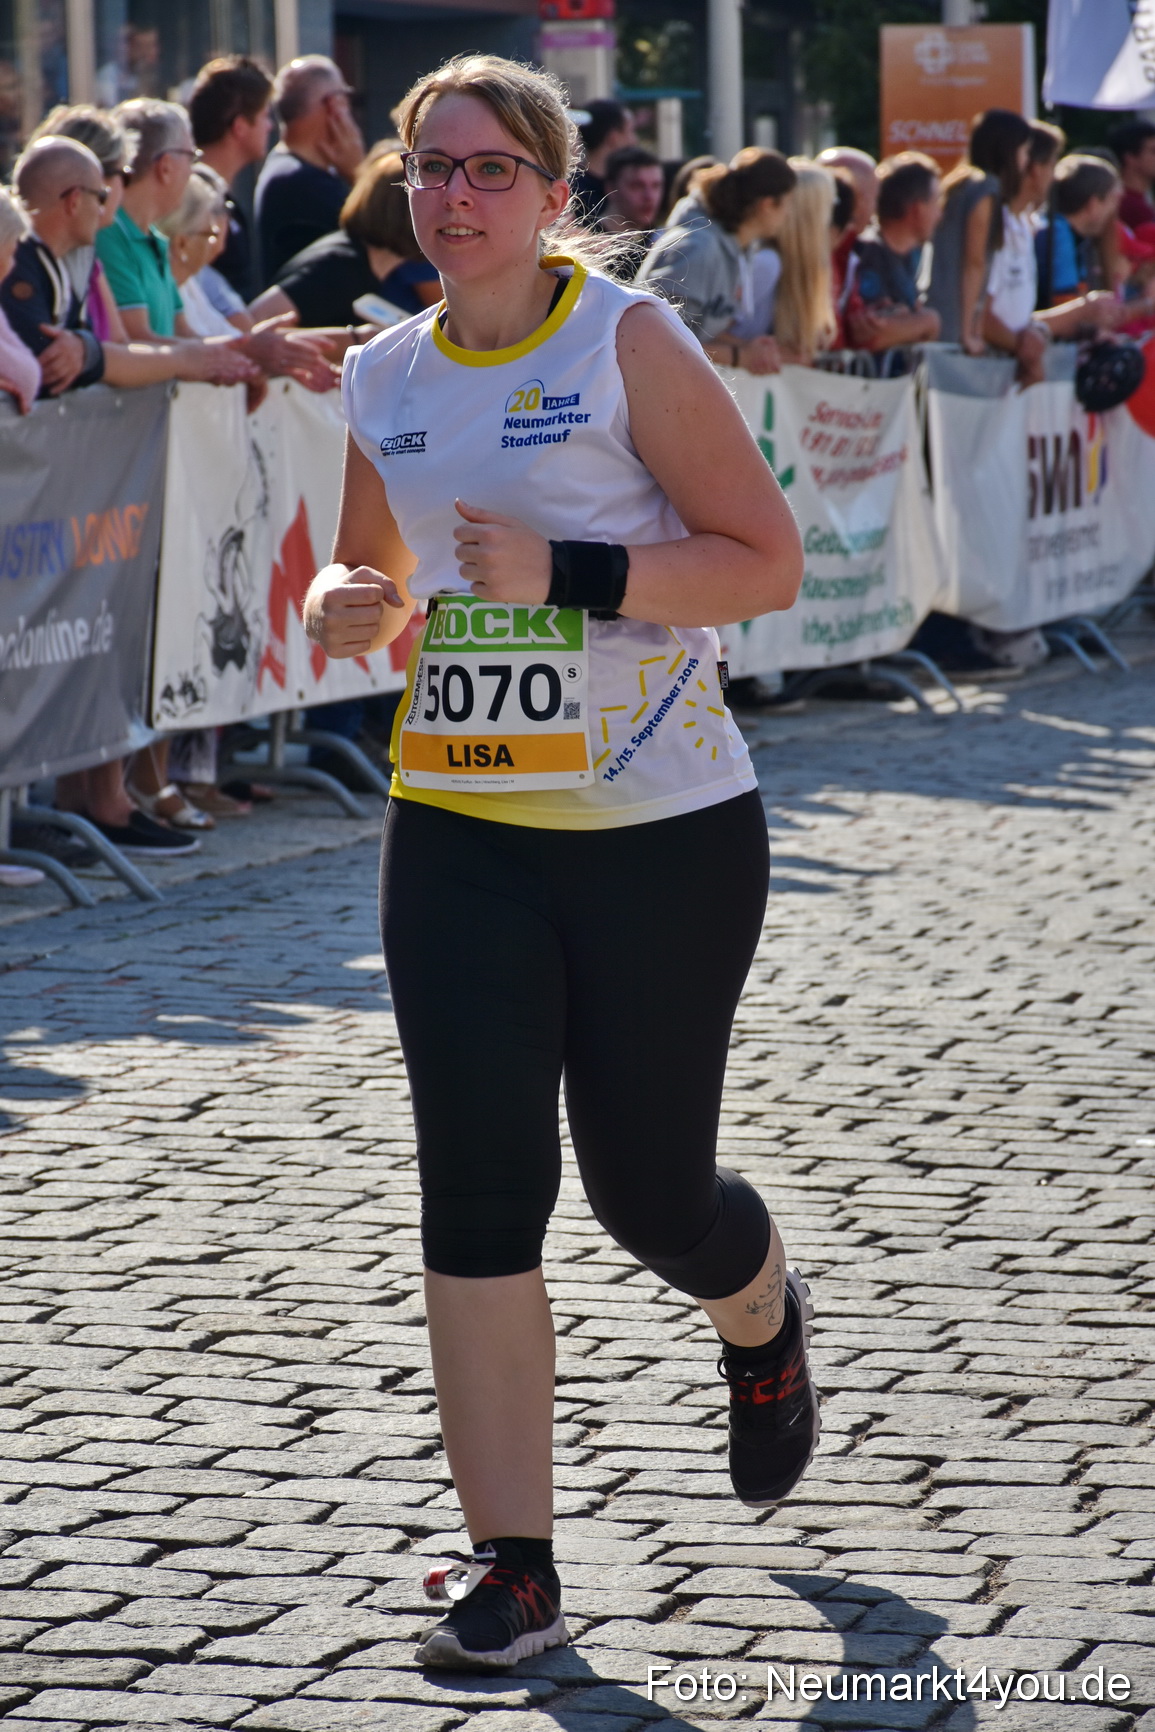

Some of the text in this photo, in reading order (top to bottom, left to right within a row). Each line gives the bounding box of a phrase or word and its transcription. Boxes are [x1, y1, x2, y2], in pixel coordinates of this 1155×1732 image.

[888, 119, 968, 144] SCHNEL
[507, 386, 578, 413] 20 JAHRE
[503, 411, 592, 430] Neumarkter
[381, 431, 427, 451] BOCK
[501, 428, 572, 449] Stadtlauf
[430, 604, 566, 644] BOCK
[424, 663, 562, 722] 5070
[603, 657, 700, 782] 14./15. September 2019
[446, 743, 515, 768] LISA
